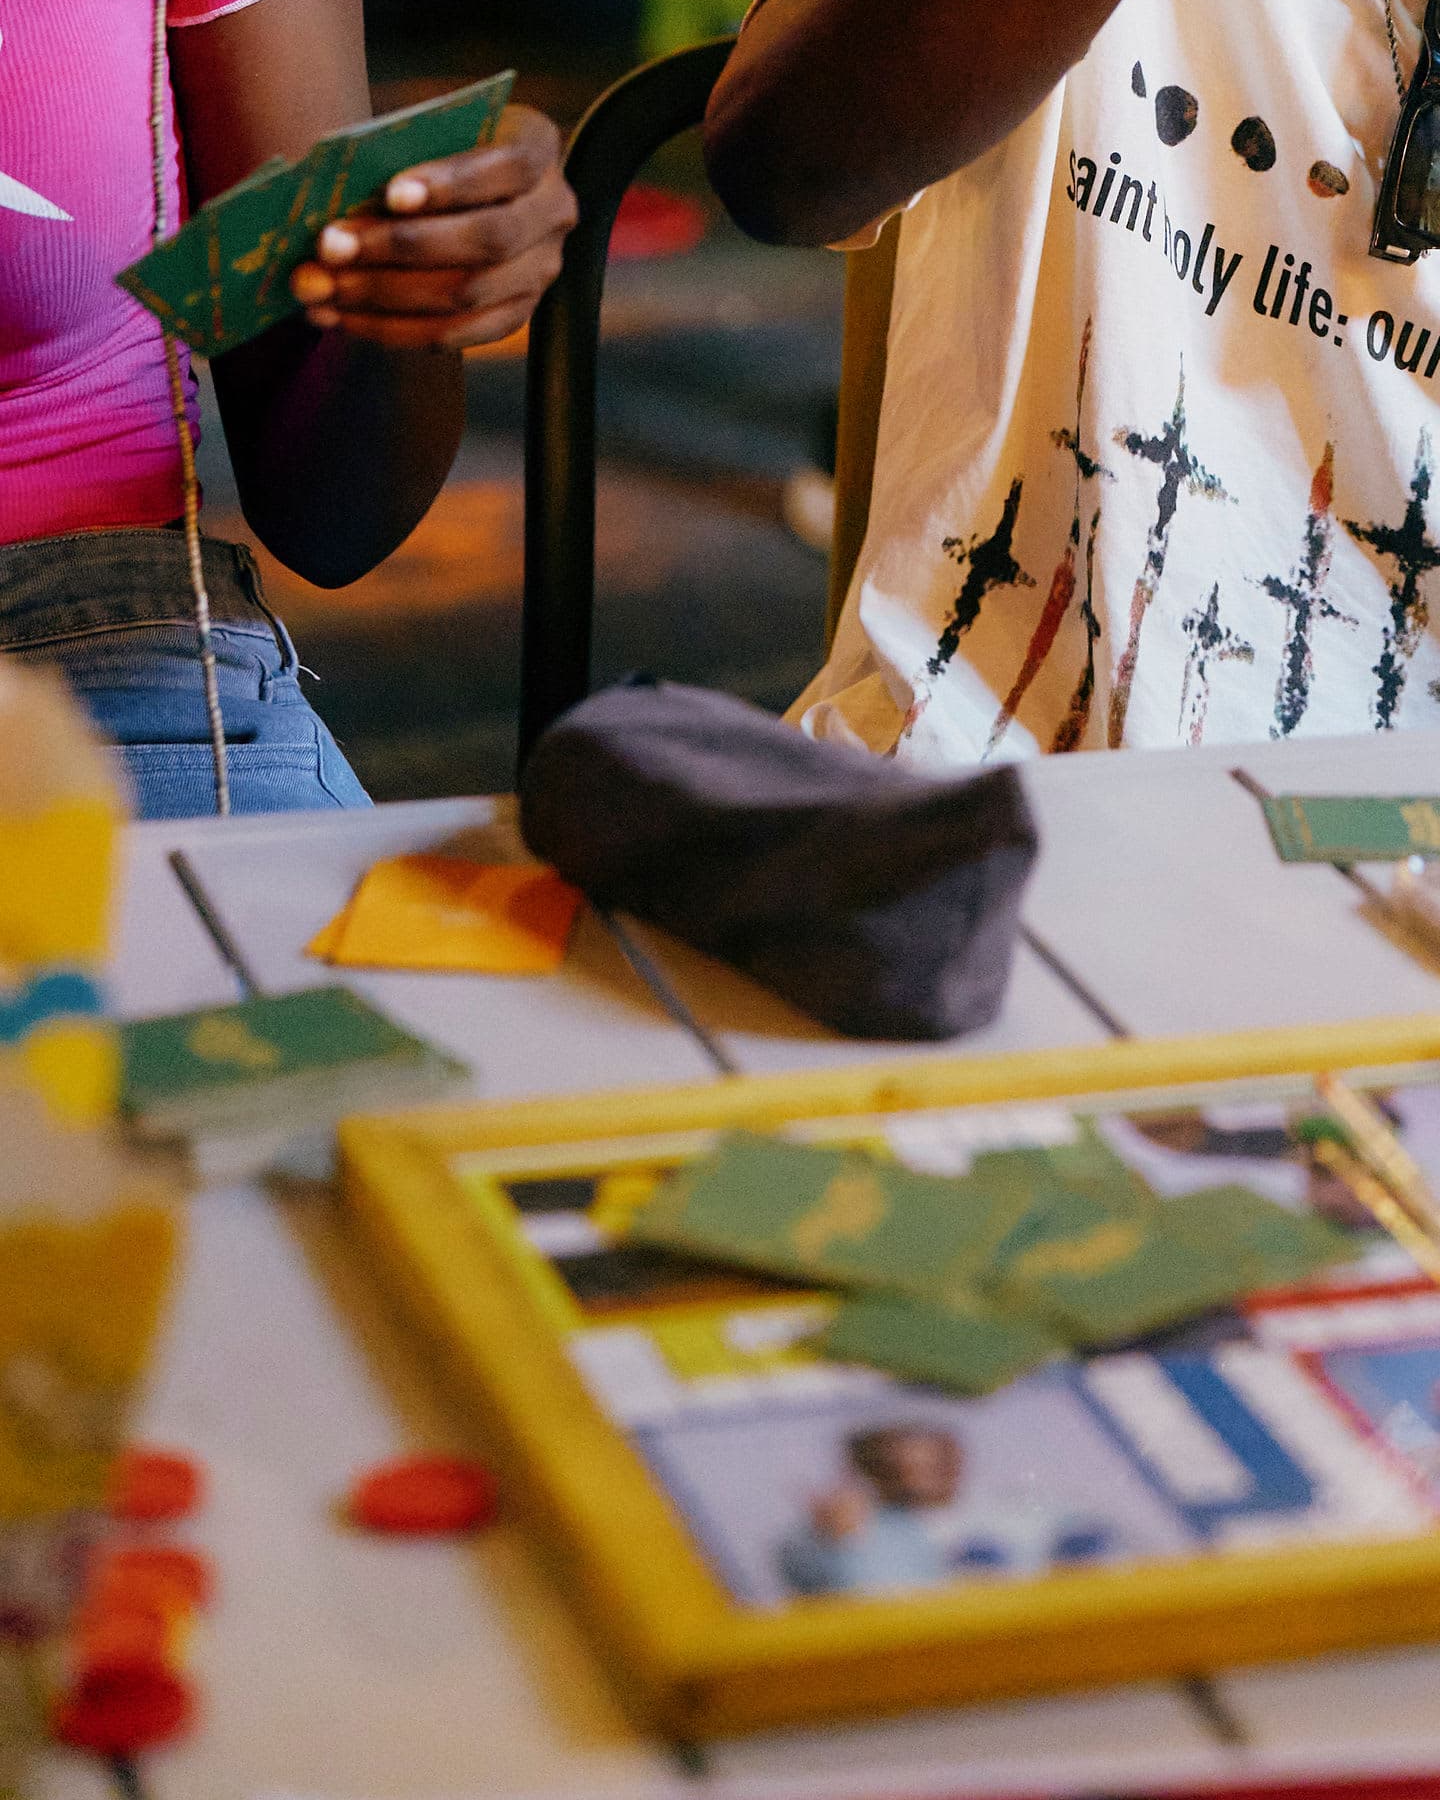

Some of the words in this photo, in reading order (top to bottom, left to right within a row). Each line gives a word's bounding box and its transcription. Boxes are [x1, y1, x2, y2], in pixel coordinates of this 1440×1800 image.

[1066, 149, 1158, 243] saint
[1163, 193, 1244, 317] holy
[1253, 244, 1349, 349] life:
